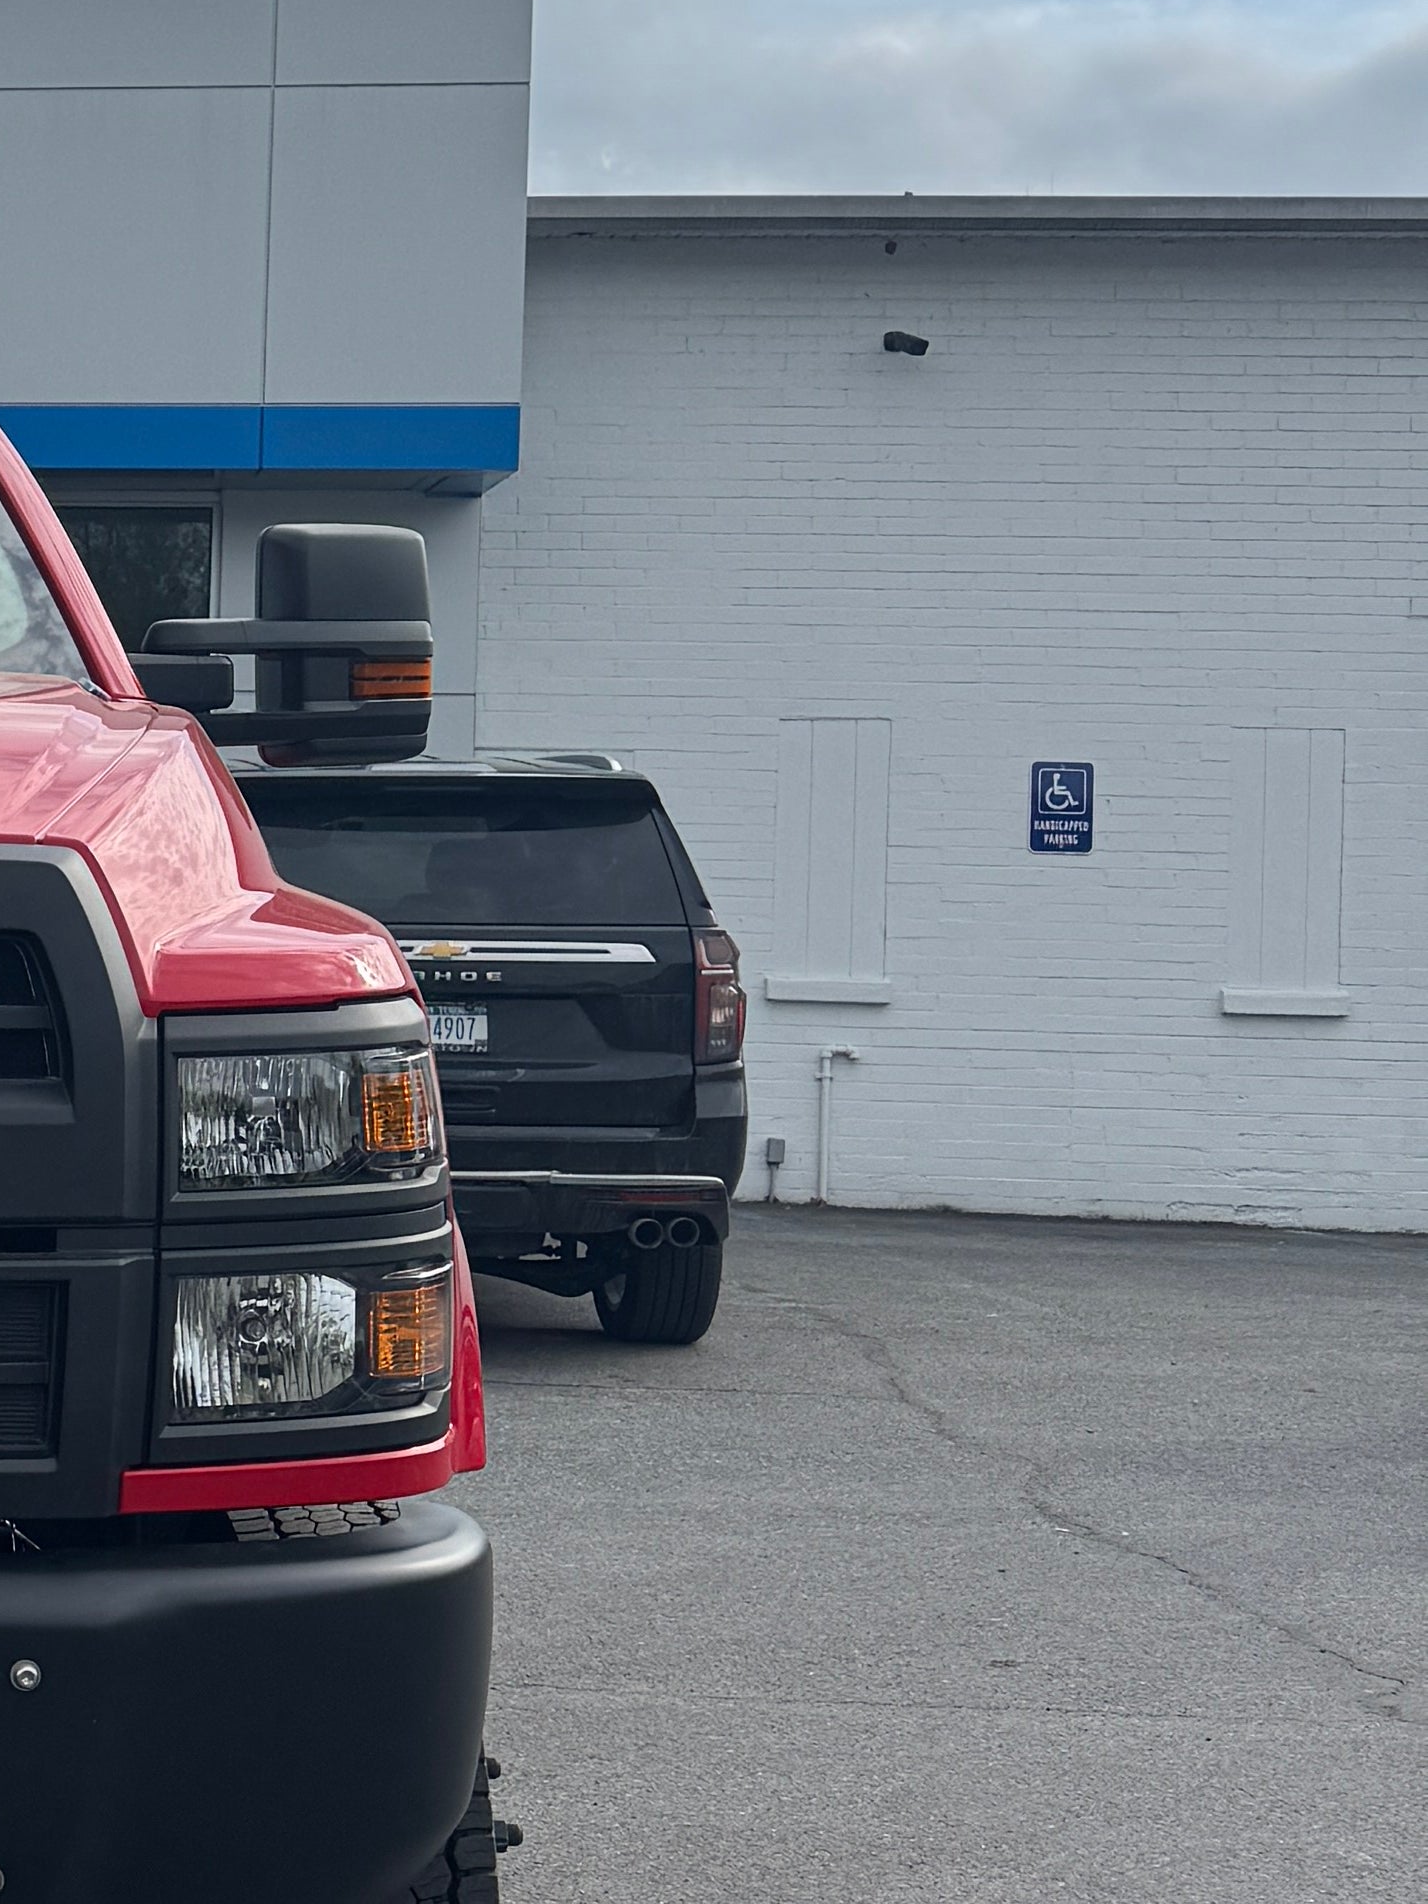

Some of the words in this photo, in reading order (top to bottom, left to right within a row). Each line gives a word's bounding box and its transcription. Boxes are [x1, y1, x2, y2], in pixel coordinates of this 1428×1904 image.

[1043, 833, 1079, 845] PARKING
[411, 970, 502, 982] AHOE
[433, 1016, 476, 1040] 4907
